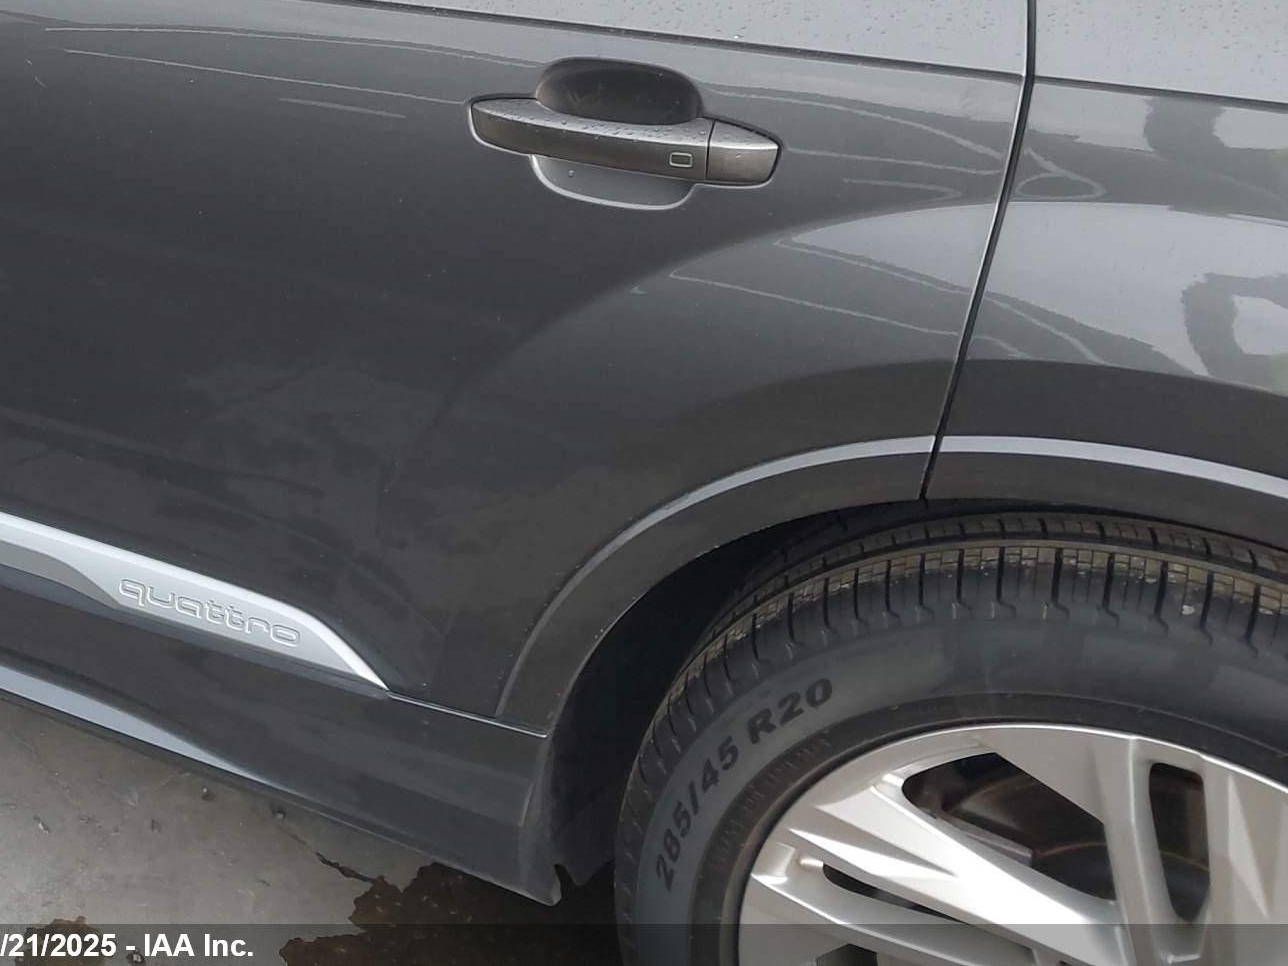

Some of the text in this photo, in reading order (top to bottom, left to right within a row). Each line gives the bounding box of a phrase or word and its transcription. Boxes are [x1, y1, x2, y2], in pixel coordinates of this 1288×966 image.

[118, 578, 301, 647] quattro
[656, 736, 739, 892] 285/45
[747, 678, 833, 745] R20
